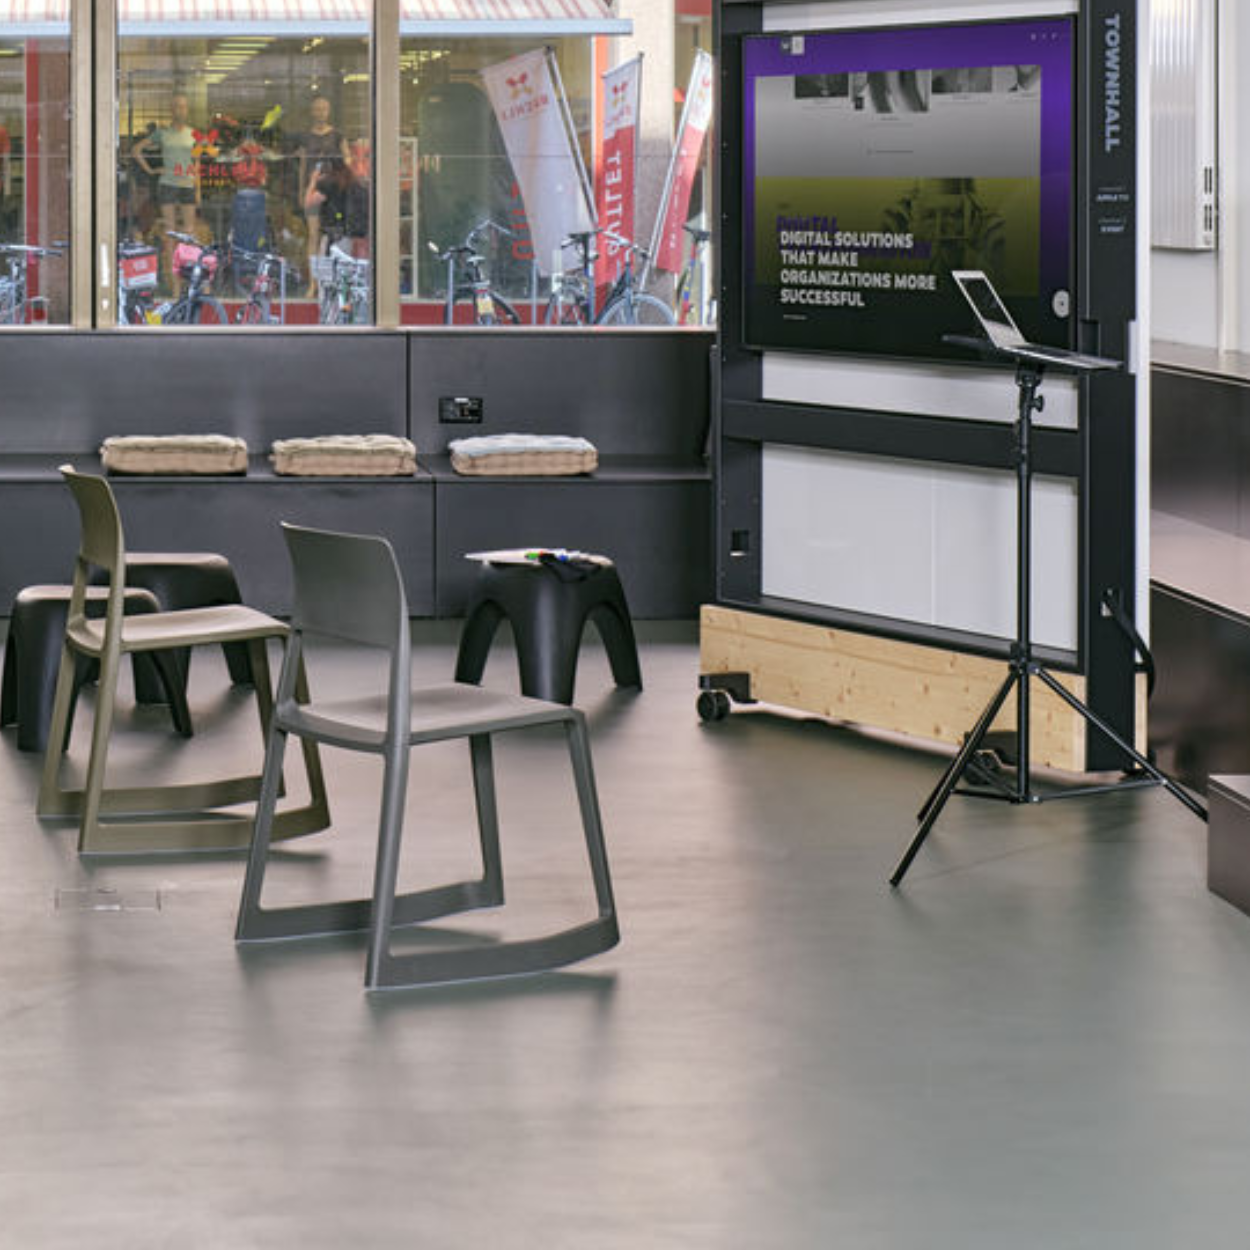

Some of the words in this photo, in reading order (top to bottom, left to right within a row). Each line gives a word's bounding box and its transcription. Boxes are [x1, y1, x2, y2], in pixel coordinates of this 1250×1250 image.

[1105, 13, 1120, 153] TOWNHALL
[780, 231, 831, 247] DIGITAL
[834, 232, 914, 248] SOLUTIONS
[781, 250, 815, 265] THAT
[817, 251, 858, 267] MAKE
[780, 268, 891, 288] ORGANIZATIONS
[894, 275, 937, 290] MORE
[780, 288, 865, 307] SUCCESSFUL
